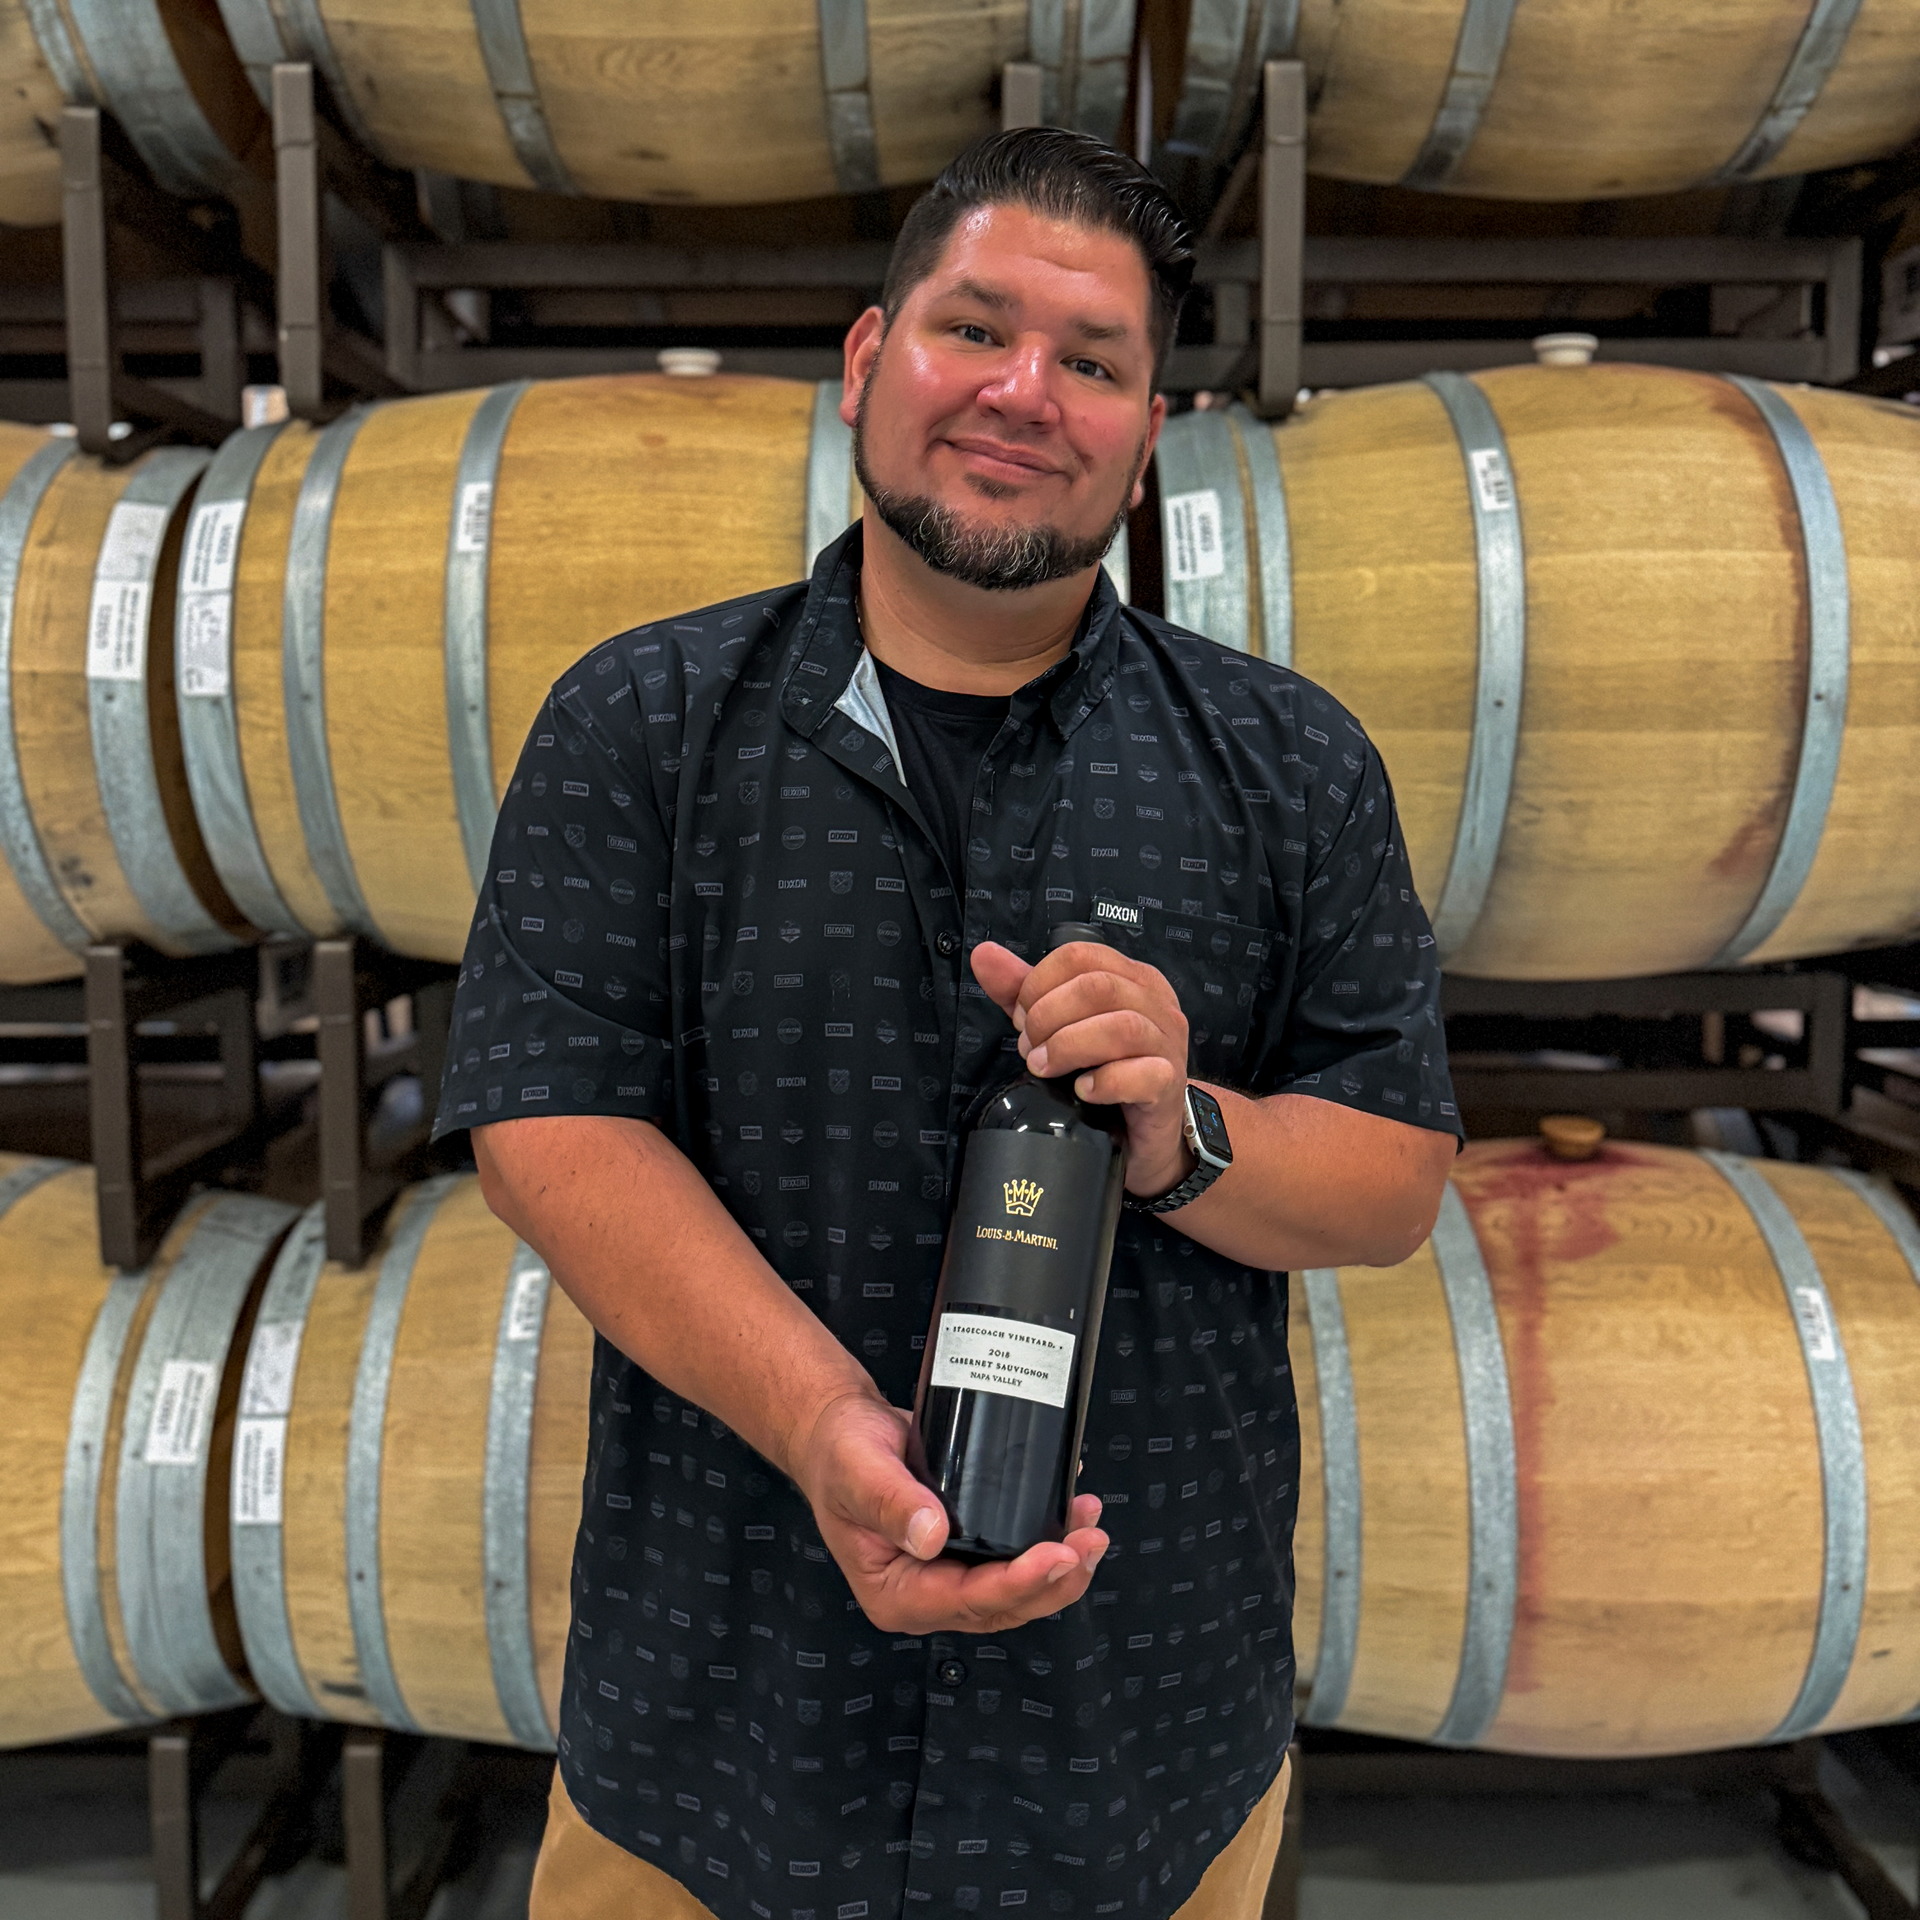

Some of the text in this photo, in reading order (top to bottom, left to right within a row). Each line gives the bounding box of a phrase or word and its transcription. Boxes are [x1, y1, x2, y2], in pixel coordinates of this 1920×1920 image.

[801, 663, 826, 674] DIXXON
[743, 681, 771, 689] DIXXON
[648, 713, 677, 724] DIXXON
[1232, 717, 1260, 725] DIXXON
[1131, 733, 1158, 742] DIXXON
[740, 747, 764, 758] DIXXON
[783, 786, 807, 796] DIXXON
[1139, 807, 1161, 817] DIXXON
[830, 833, 855, 841] DIXXON
[611, 838, 635, 849] DIXXON
[1091, 847, 1118, 857] DIXXON
[564, 876, 590, 889] DIXXON
[778, 879, 807, 889] DIXXON
[877, 880, 902, 890] DIXXON
[1138, 895, 1163, 909] DIXXON
[1096, 903, 1139, 924] DIXXON
[827, 925, 851, 935] DIXXON
[1168, 928, 1190, 938] DIXXON
[606, 932, 636, 947] DIXXON
[557, 973, 581, 984] DIXXON
[776, 976, 801, 985] DIXXON
[874, 976, 900, 989] DIXXON
[523, 989, 547, 1003] DIXXON
[732, 1028, 758, 1039] DIXXON
[914, 1032, 940, 1043] DIXXON
[567, 1036, 599, 1047] DIXXON
[777, 1077, 806, 1087] DIXXON
[875, 1078, 899, 1088] DIXXON
[523, 1088, 547, 1098] DIXXON
[617, 1086, 645, 1096] DIXXON
[828, 1128, 849, 1136] DIXXON
[782, 1178, 808, 1187] DIXXON
[868, 1180, 899, 1191] DIXXON
[953, 1326, 1005, 1338] STAGECOACH
[988, 1349, 1011, 1359] 2018
[950, 1356, 1049, 1380] CABERNET SAUVIGNON
[970, 1371, 1023, 1387] NAPA VALLEY
[1103, 1494, 1129, 1504] DIXXON
